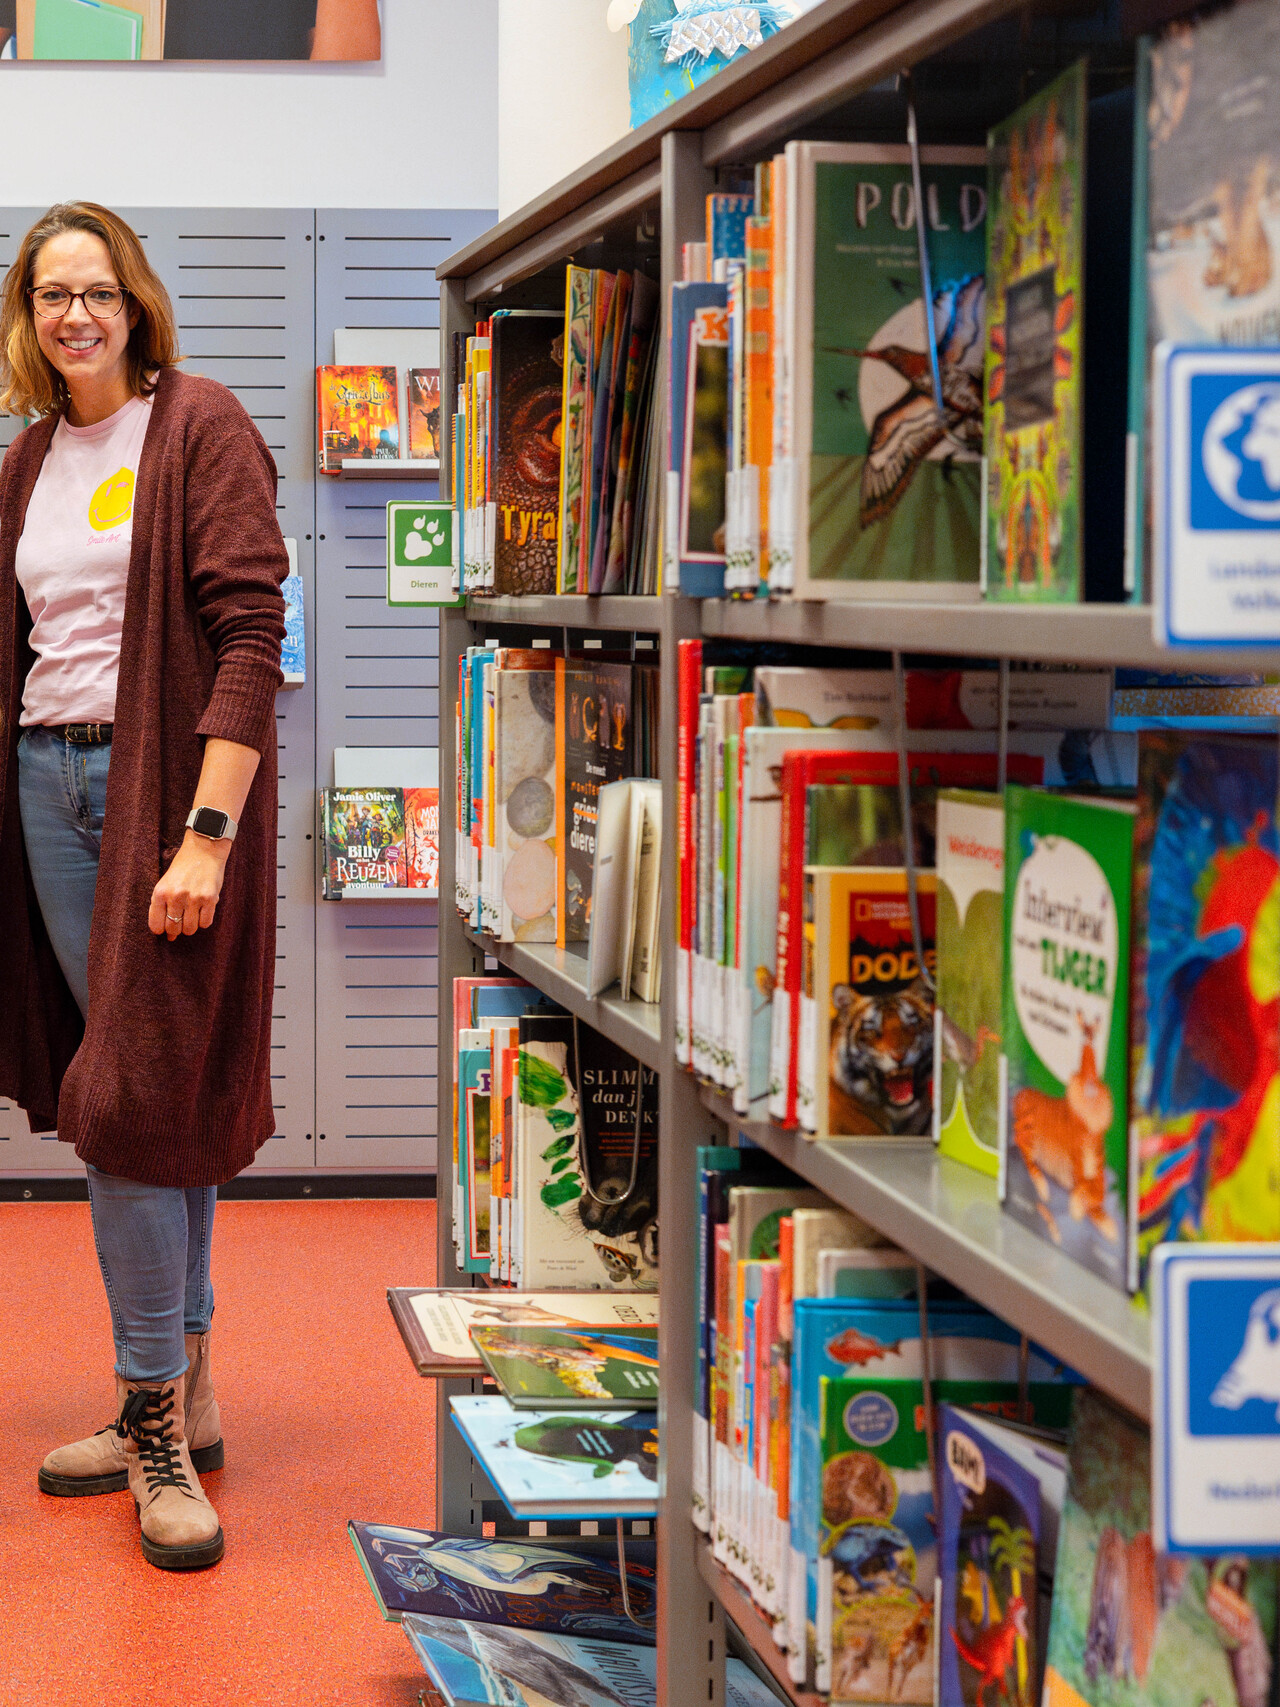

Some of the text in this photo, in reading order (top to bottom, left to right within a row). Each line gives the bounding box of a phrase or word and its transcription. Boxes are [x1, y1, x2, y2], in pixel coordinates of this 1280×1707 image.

[411, 579, 438, 588] Dieren
[333, 792, 397, 802] Jamie Oliver
[348, 845, 381, 861] Billy
[336, 857, 398, 884] REUZEN
[592, 1088, 625, 1104] dan
